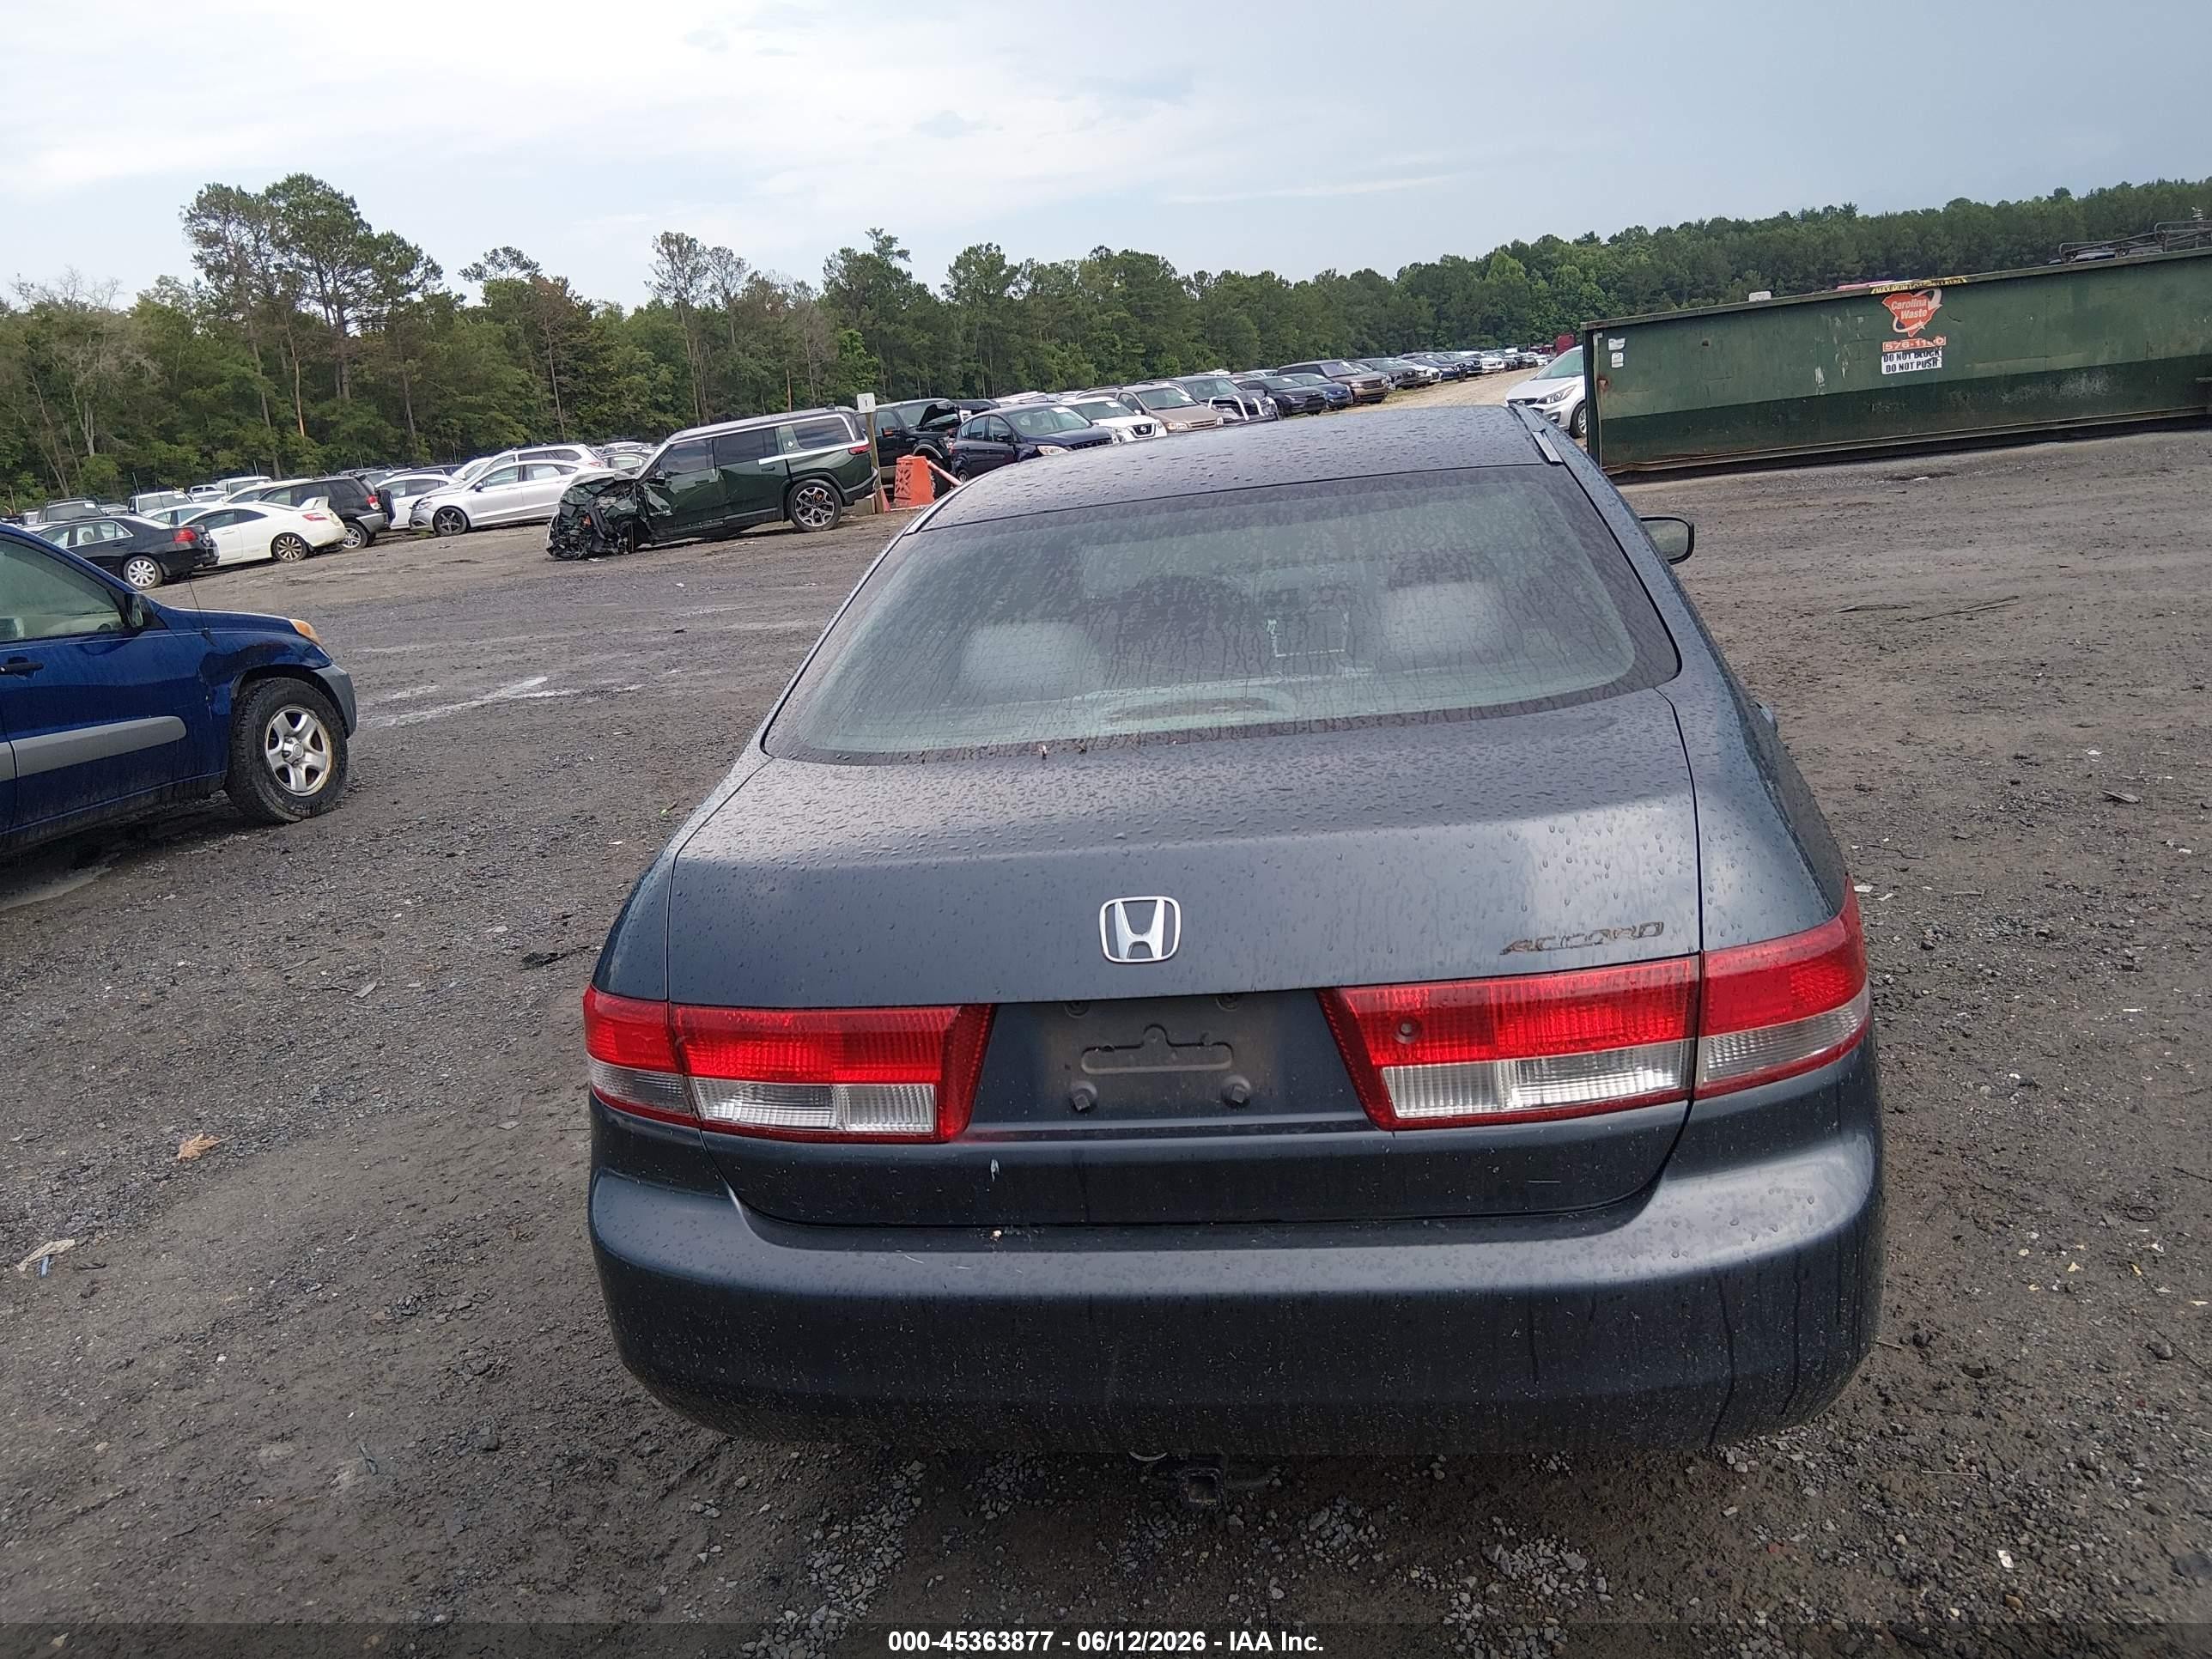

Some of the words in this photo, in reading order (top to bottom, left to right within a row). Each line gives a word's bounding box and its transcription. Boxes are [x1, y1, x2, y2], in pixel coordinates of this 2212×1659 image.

[1891, 299, 1927, 310] Carolina
[1900, 309, 1928, 319] Waste
[1883, 353, 1894, 362] DO
[1896, 351, 1912, 362] NOT
[1886, 363, 1897, 373] DO
[1899, 362, 1915, 371] NOT
[1916, 357, 1938, 369] PUSH
